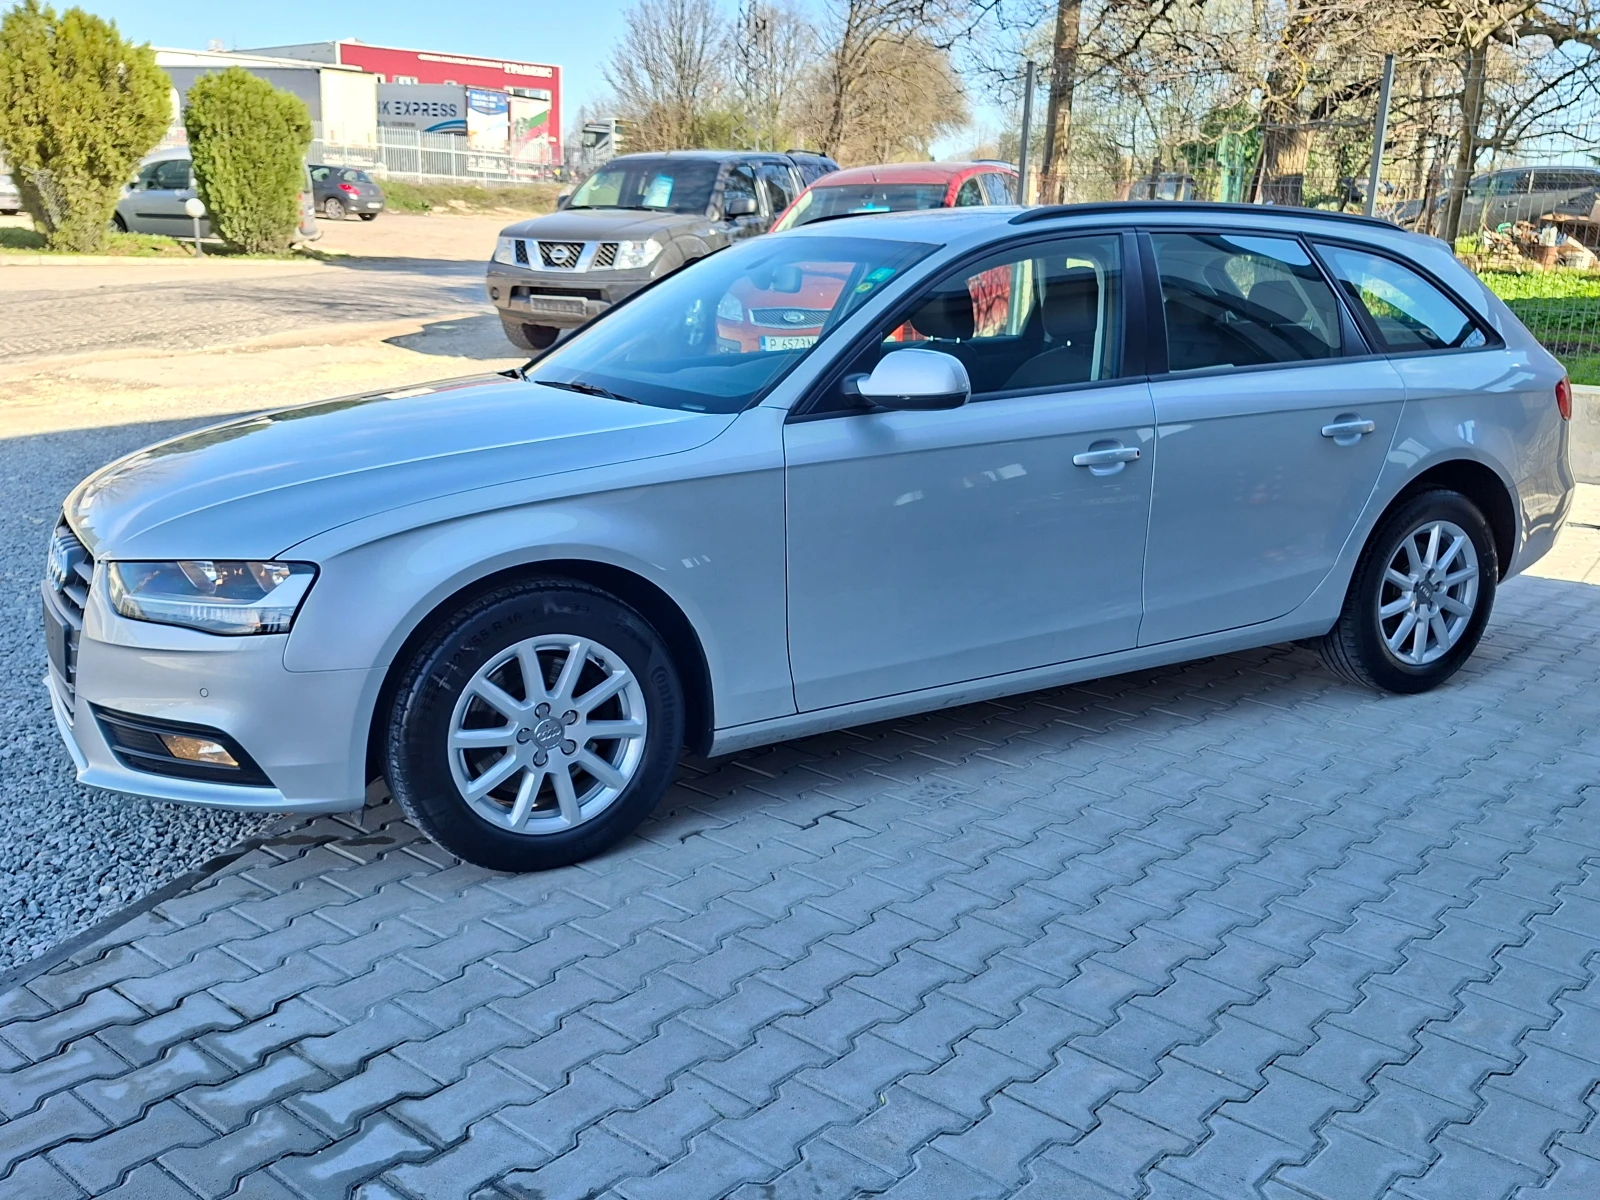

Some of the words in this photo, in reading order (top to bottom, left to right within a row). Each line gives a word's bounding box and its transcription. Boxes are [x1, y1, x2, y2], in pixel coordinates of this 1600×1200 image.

[377, 100, 391, 115] K
[394, 101, 457, 117] EXPRESS
[770, 338, 777, 350] P
